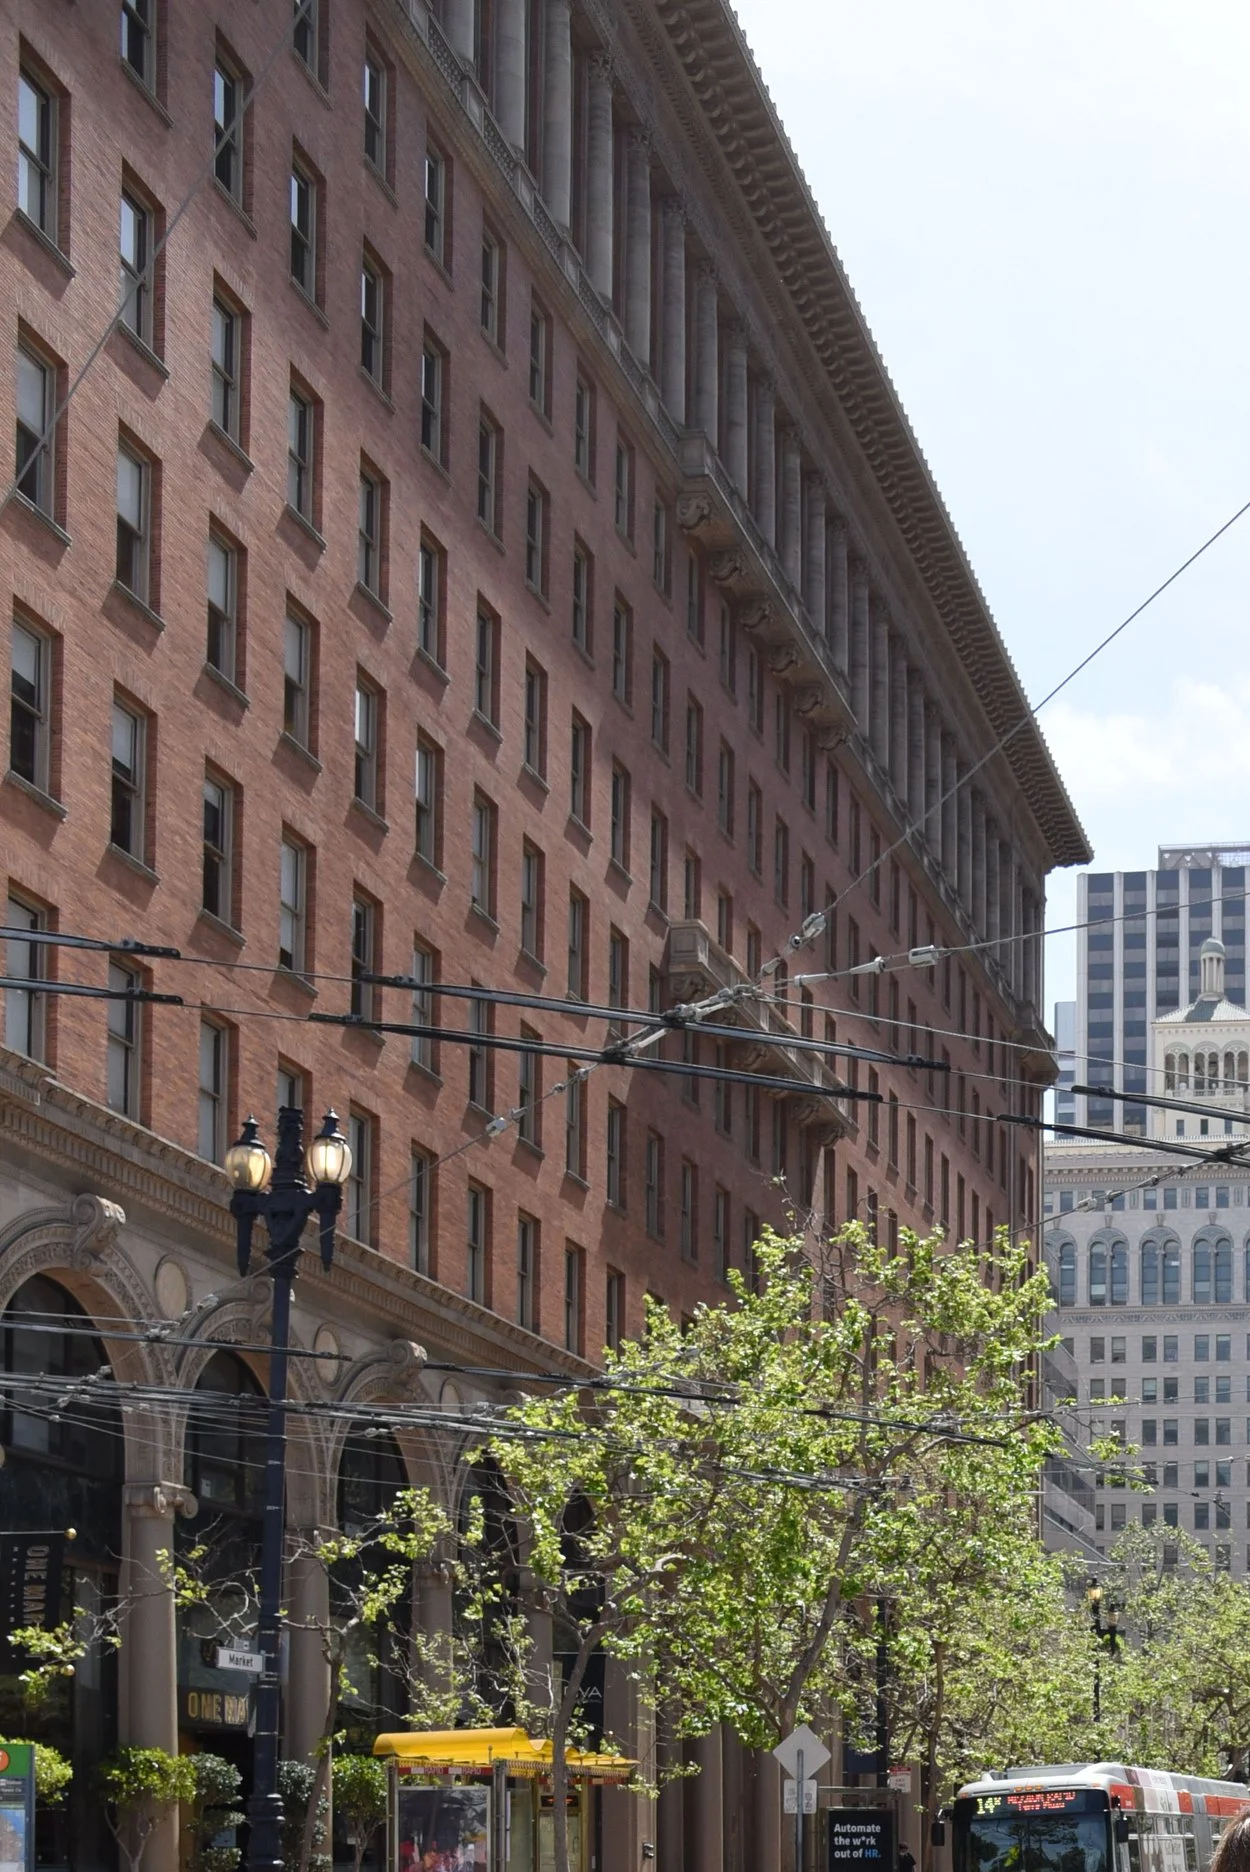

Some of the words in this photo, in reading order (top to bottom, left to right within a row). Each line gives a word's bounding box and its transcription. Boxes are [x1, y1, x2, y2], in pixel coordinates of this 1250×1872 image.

[24, 1545, 49, 1581] ONE
[229, 1653, 254, 1668] Market
[188, 1691, 222, 1723] ONE
[834, 1823, 881, 1833] Automate
[834, 1836, 850, 1846] the
[834, 1849, 851, 1859] out
[852, 1848, 863, 1859] of
[864, 1849, 882, 1859] HR.
